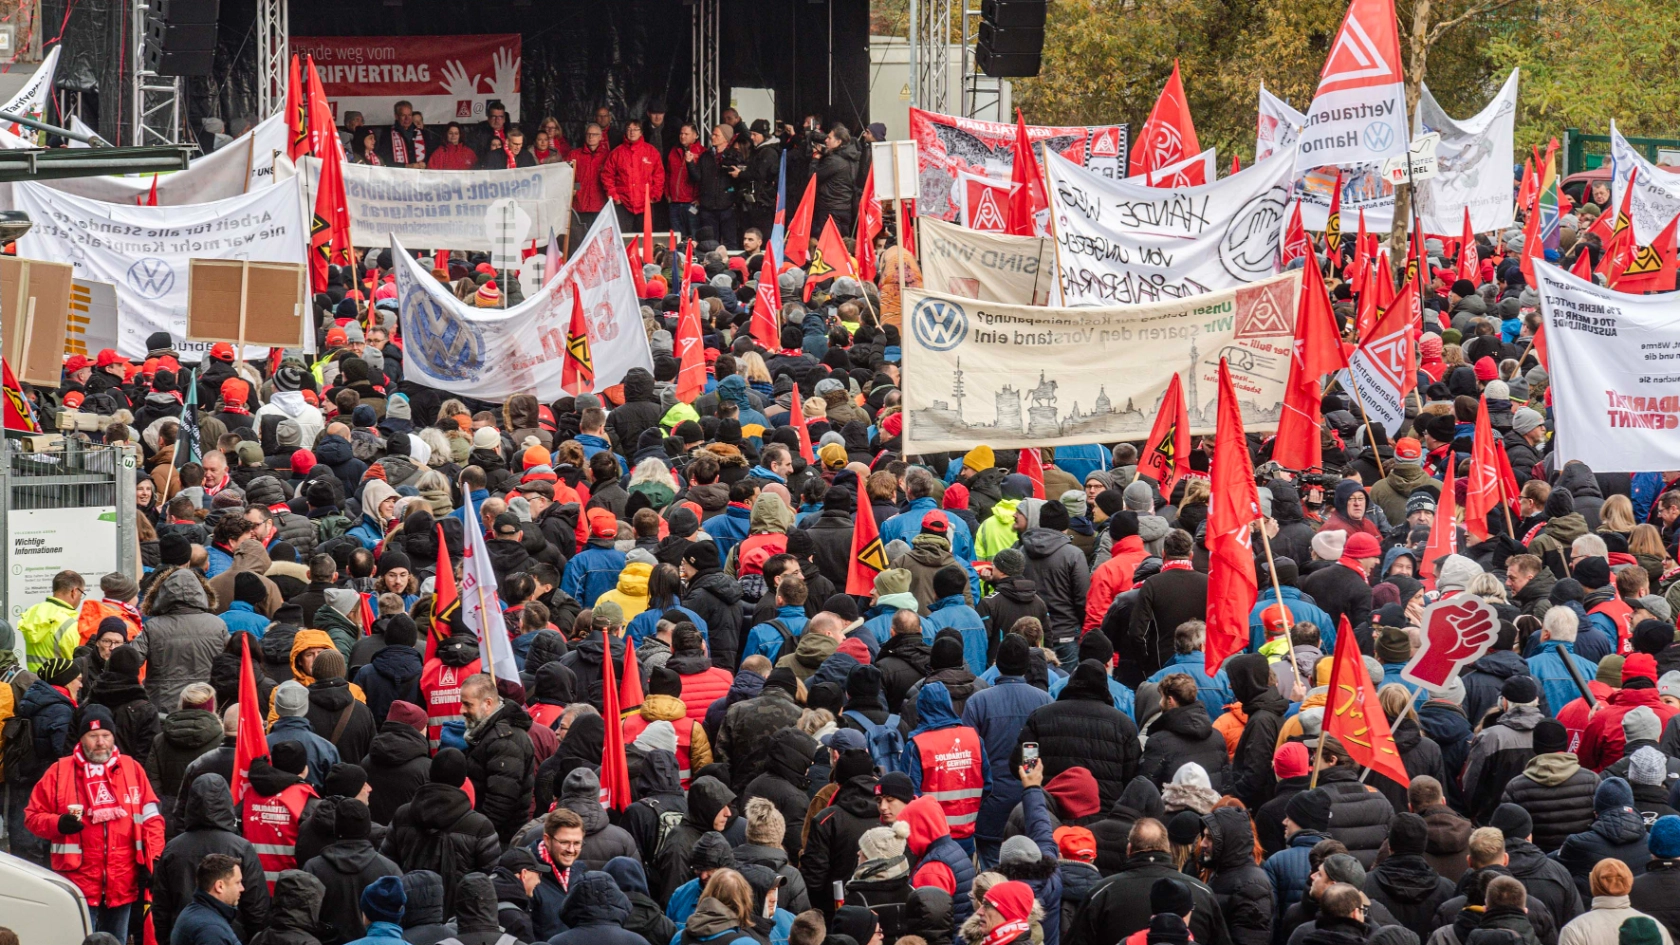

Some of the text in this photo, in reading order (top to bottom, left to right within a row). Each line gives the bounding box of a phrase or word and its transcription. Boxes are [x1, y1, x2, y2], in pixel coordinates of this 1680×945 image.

[336, 47, 364, 63] weg
[366, 46, 395, 60] vom
[1357, 384, 1394, 422] Hannover
[14, 537, 45, 547] Wichtige
[14, 546, 63, 555] Informationen
